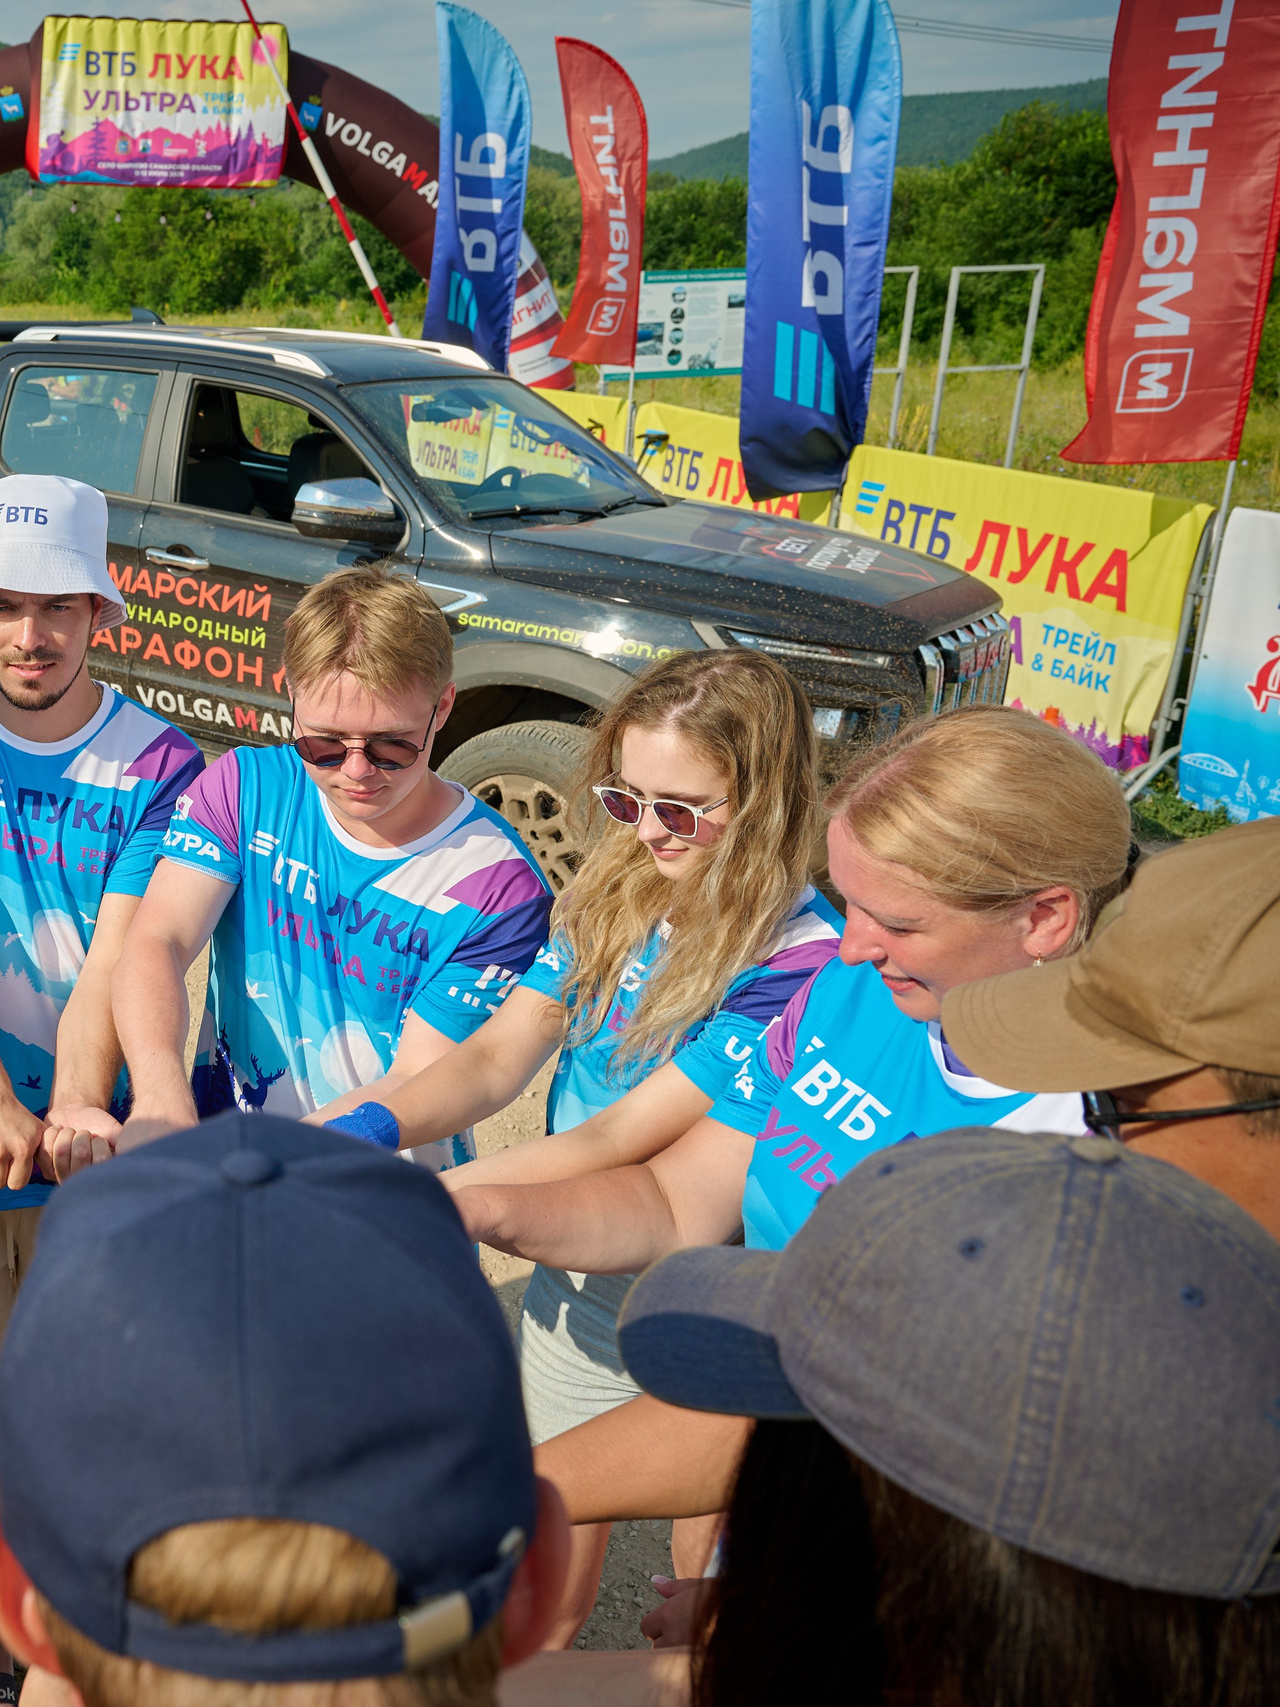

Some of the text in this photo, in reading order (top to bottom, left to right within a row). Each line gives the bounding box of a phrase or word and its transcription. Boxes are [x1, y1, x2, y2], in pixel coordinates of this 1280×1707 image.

[85, 50, 245, 80] ВТБ ЛУКА
[83, 89, 196, 113] УЛЬТРА
[325, 111, 439, 209] VOLGAMA
[454, 131, 508, 272] ВТБ
[801, 100, 855, 317] ВТБ
[662, 444, 704, 492] ВТБ
[5, 505, 49, 526] ВТБ
[881, 499, 1130, 613] ВТБ ЛУКА
[108, 561, 272, 622] МАРСКИЙ
[126, 602, 267, 649] УНАРОДНЫЙ
[738, 636, 755, 644] JAC
[1042, 623, 1117, 667] ТРЕЙЛ
[90, 625, 264, 687] АРАФОН
[1031, 653, 1044, 673] &
[1049, 659, 1112, 694] БАЙК
[17, 787, 127, 838] ЛУКА
[326, 892, 430, 964] ЛУКА
[791, 1058, 892, 1141] ВТБ
[756, 1105, 839, 1193] УЛЬ
